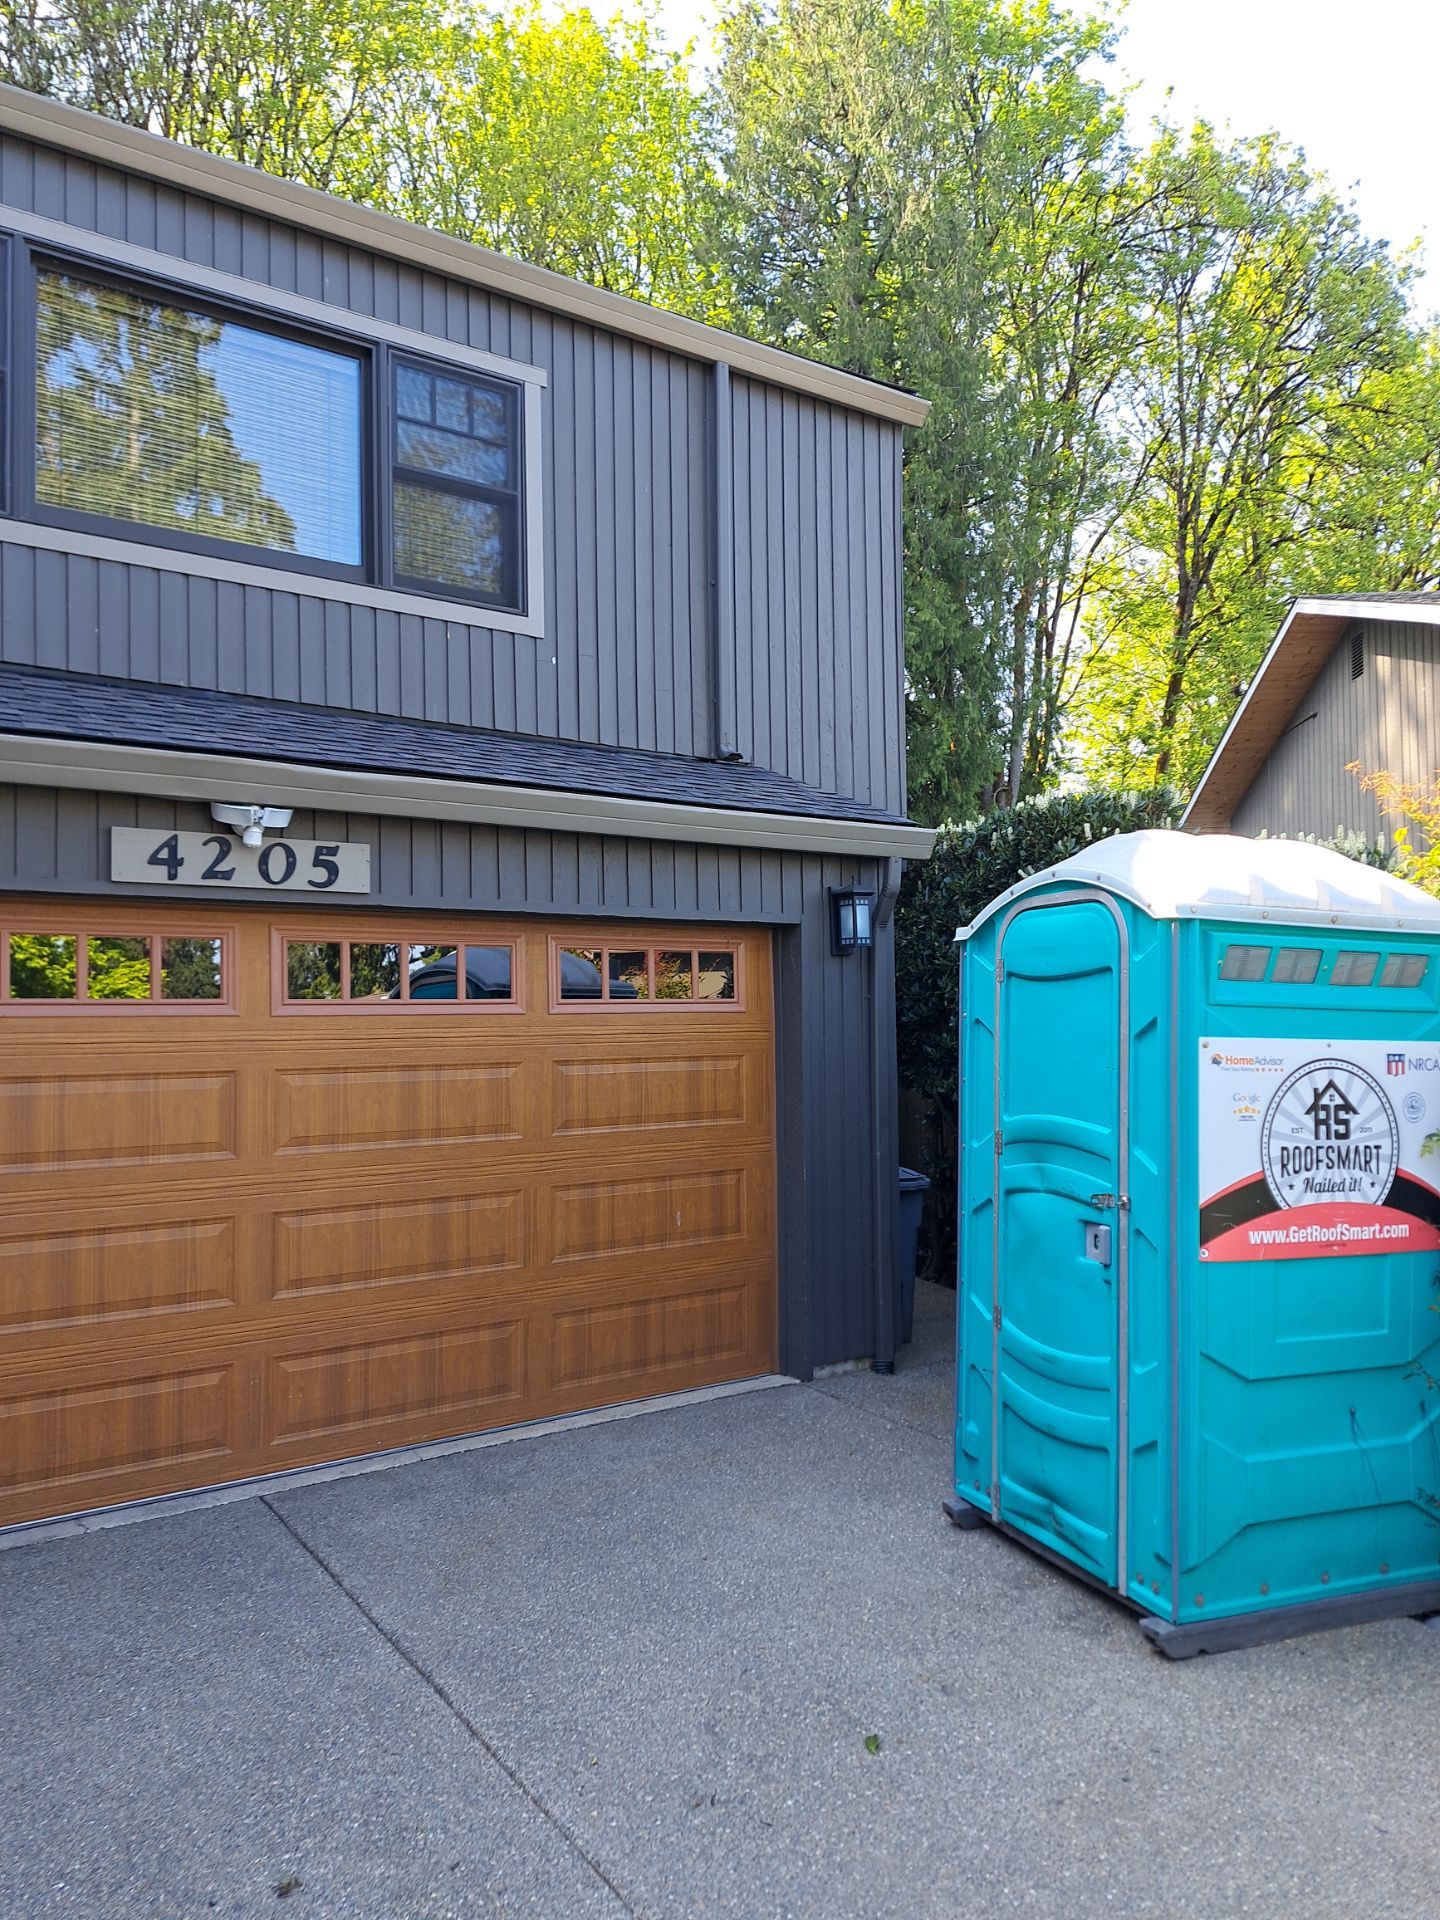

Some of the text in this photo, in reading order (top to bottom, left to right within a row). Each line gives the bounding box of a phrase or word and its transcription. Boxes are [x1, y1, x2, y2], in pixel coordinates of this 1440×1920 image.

[147, 833, 340, 889] 4205
[1225, 1055, 1284, 1066] HomeAdvisor
[1408, 1057, 1440, 1071] NRCA
[1233, 1093, 1261, 1105] Google
[1314, 1104, 1351, 1140] RS
[1280, 1145, 1382, 1178] ROOFSMART
[1303, 1176, 1363, 1194] Nailed it!
[1249, 1223, 1409, 1244] www.GetRoofSmart.com
